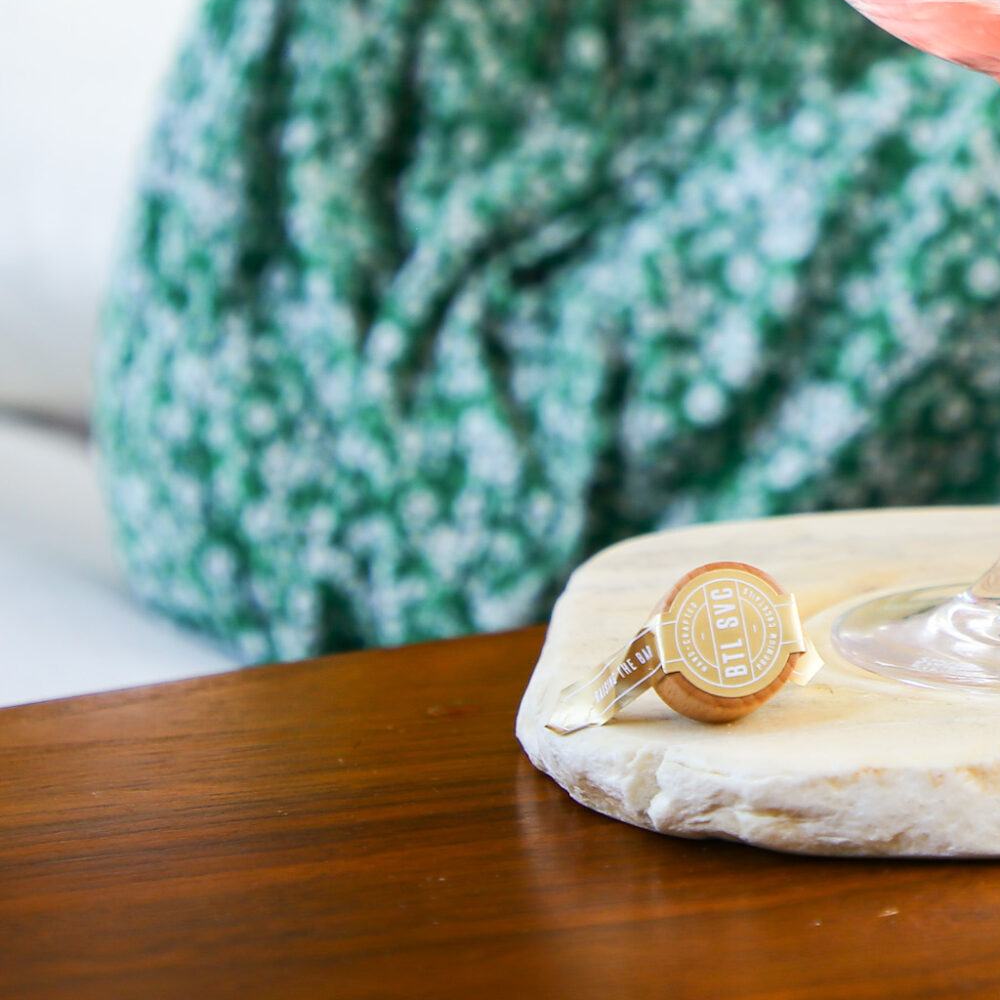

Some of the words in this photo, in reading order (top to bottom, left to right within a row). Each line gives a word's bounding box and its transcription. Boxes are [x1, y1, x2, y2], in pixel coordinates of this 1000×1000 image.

[709, 586, 740, 630] SVC
[615, 658, 638, 680] THE
[719, 637, 749, 679] BTL
[755, 633, 779, 671] PREMIUM
